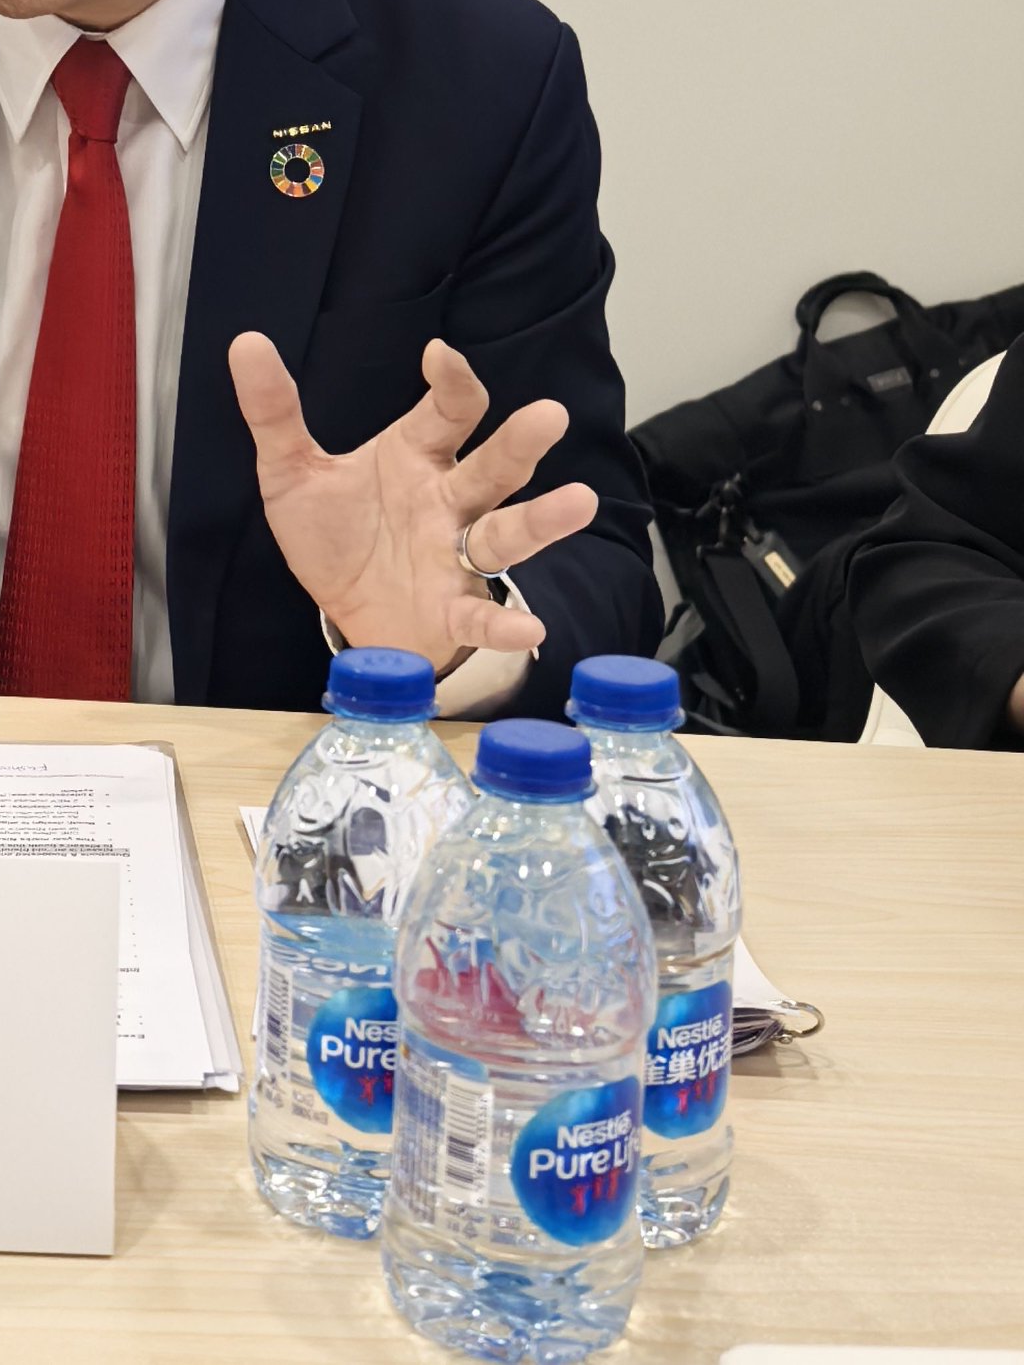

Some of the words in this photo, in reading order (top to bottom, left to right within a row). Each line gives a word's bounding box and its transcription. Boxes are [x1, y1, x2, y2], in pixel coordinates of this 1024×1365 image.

[272, 120, 332, 138] NISSAN
[344, 1017, 397, 1043] Nes
[320, 1034, 397, 1070] Pure
[528, 1147, 611, 1181] Pure
